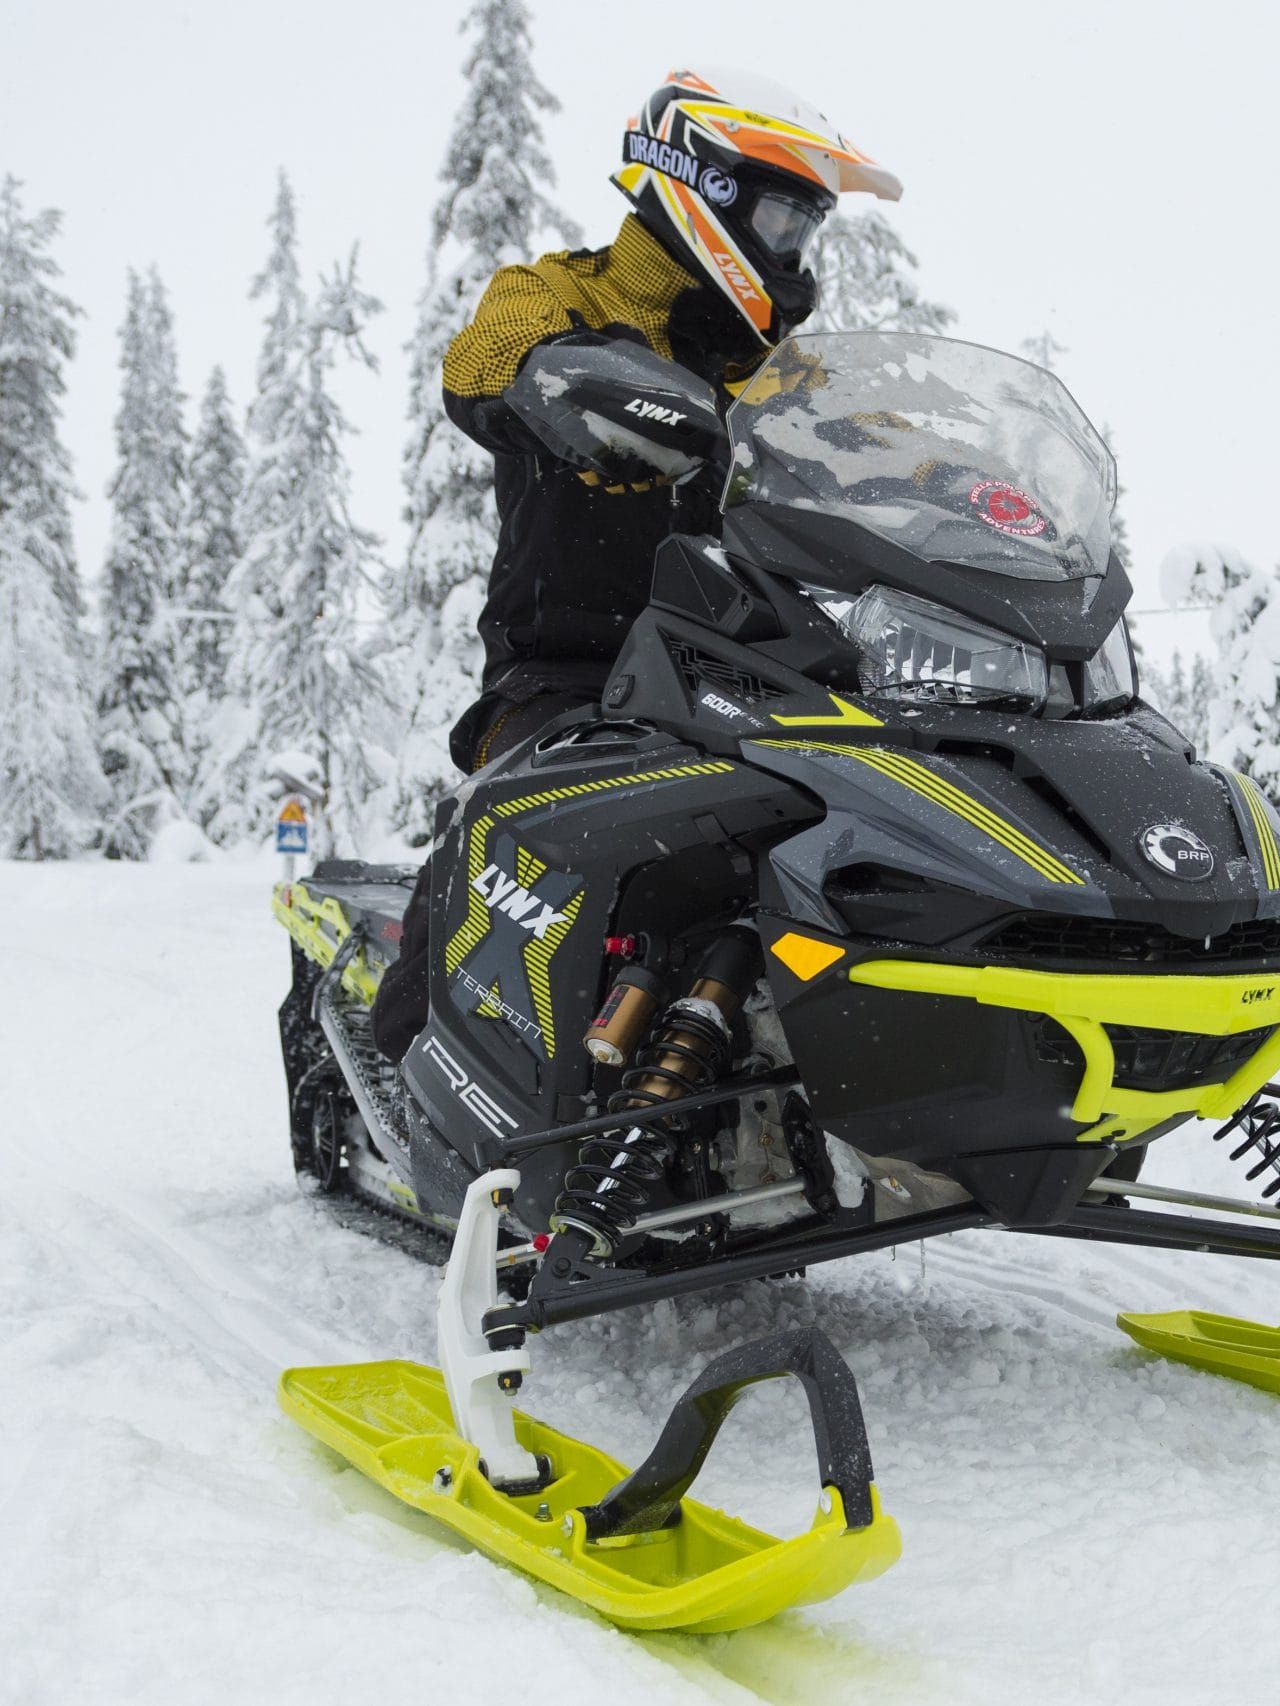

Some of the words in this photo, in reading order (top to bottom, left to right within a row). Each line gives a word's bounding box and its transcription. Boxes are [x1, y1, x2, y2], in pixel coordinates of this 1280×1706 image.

[628, 134, 698, 187] DRAGON
[713, 251, 760, 302] LYNX
[623, 398, 688, 426] LYNX
[970, 481, 993, 504] STELLA
[977, 512, 1045, 535] ADVENTURES
[701, 693, 742, 719] 600R
[1178, 850, 1209, 861] BRP
[470, 862, 569, 940] LYNX
[455, 966, 542, 1040] TERRAIN
[422, 1036, 519, 1138] RE
